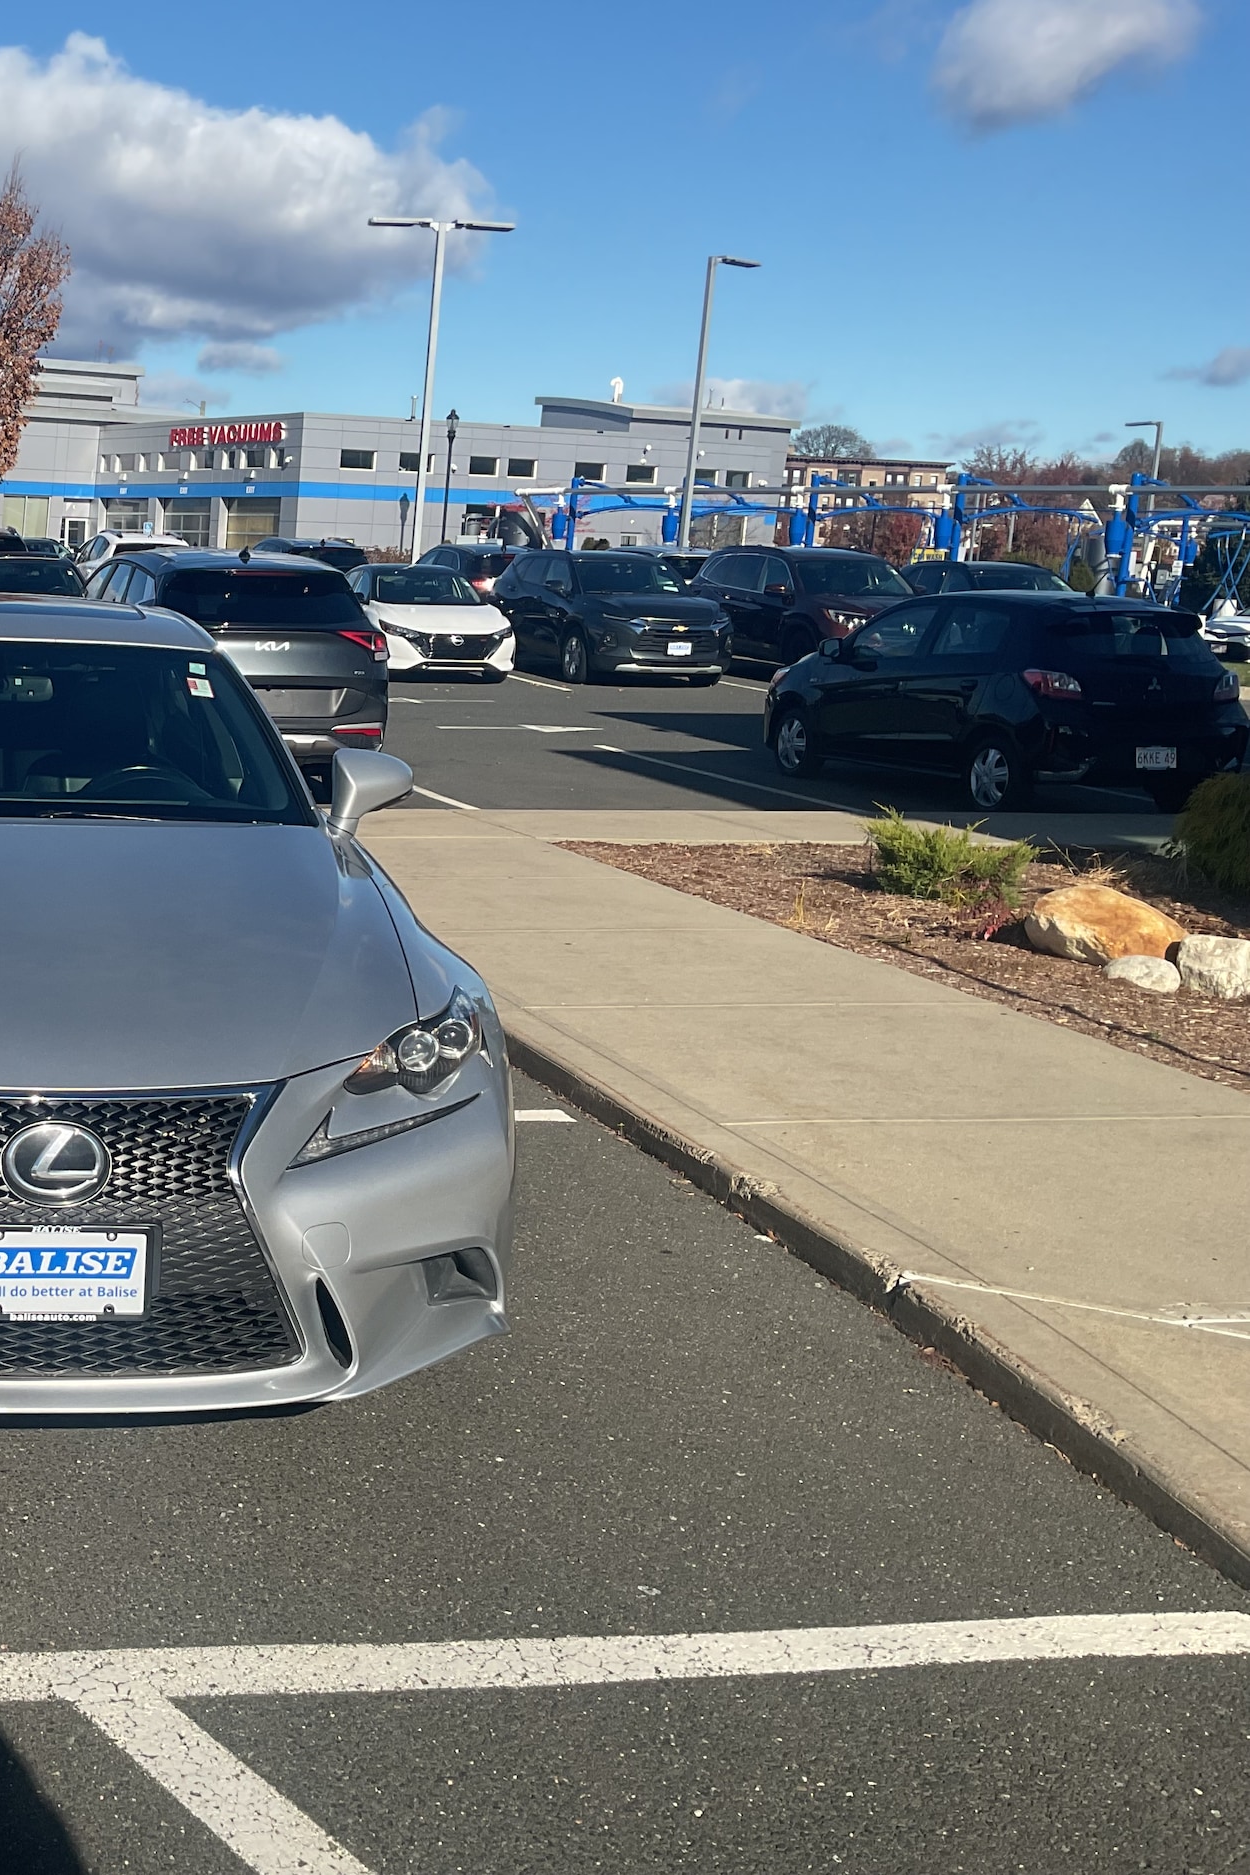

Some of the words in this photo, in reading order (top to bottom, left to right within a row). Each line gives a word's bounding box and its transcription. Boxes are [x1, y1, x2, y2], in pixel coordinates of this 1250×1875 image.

[170, 427, 208, 446] FREE
[208, 422, 286, 445] VACUUMS
[1137, 751, 1161, 764] 6KKE
[10, 1285, 28, 1298] do
[32, 1285, 75, 1298] better
[78, 1287, 93, 1298] at
[98, 1285, 138, 1298] Balise
[9, 1311, 97, 1322] baliseauto.com
